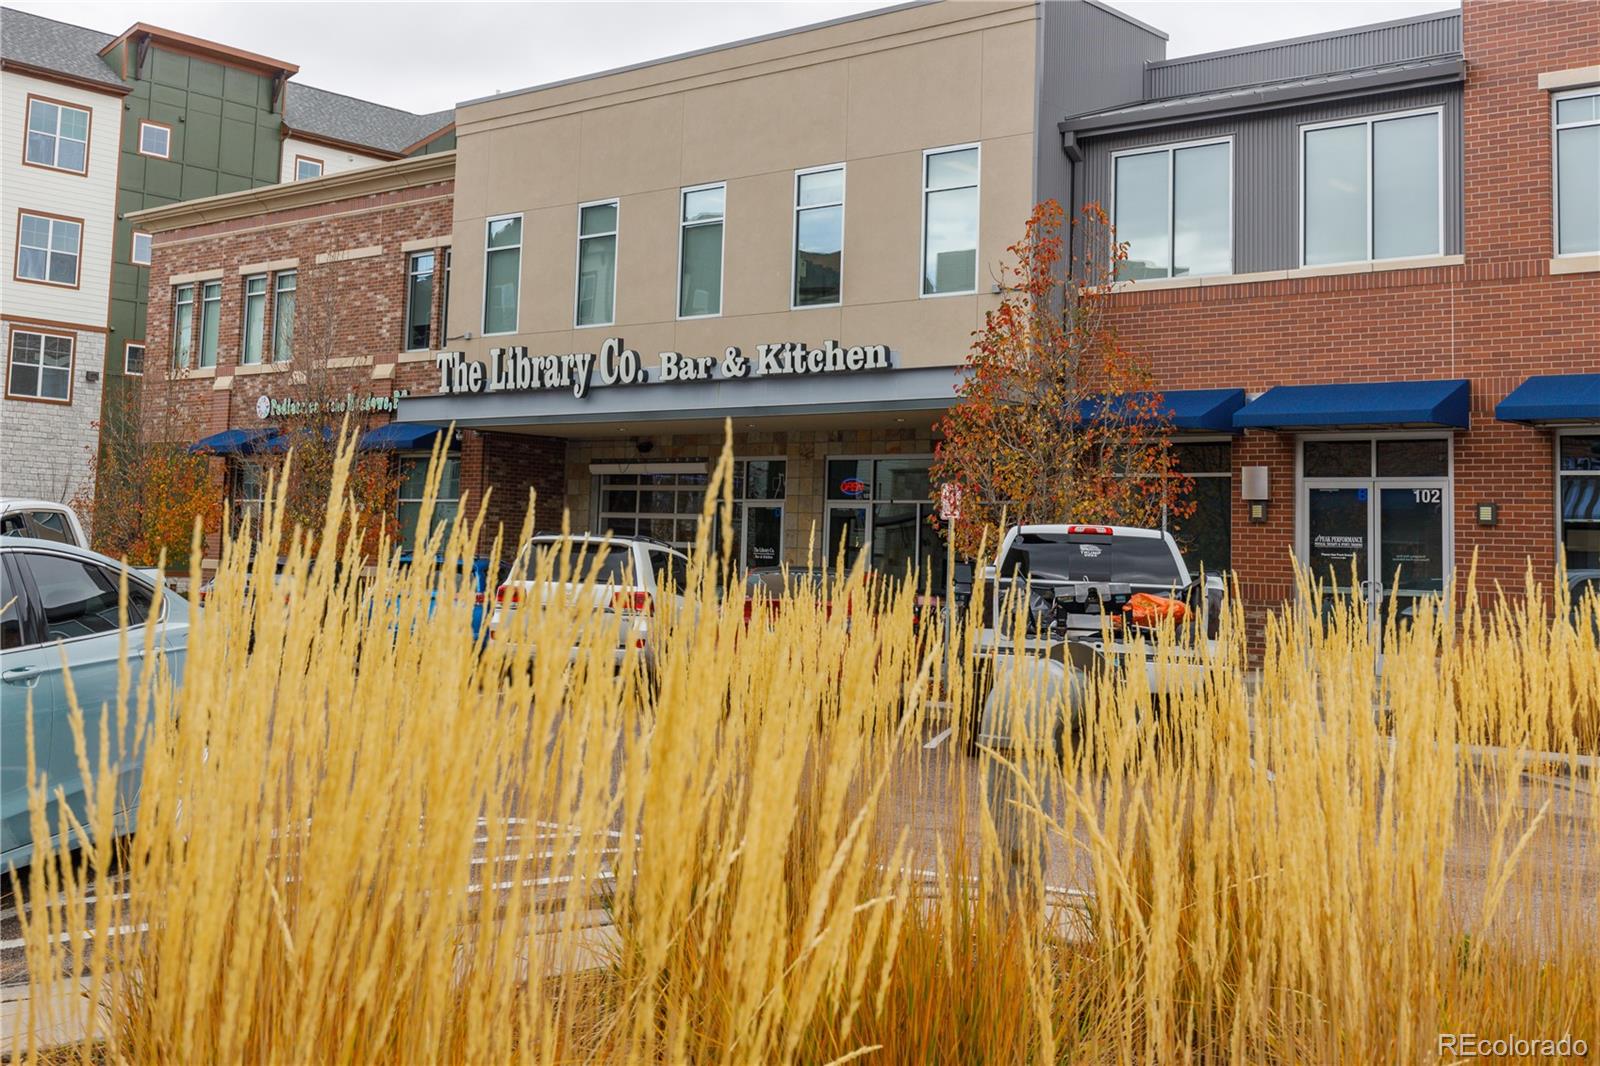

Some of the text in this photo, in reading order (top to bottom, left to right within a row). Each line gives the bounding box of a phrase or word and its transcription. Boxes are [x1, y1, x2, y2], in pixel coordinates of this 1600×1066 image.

[437, 337, 892, 398] The Library Co. Bar & Kitchen
[1413, 489, 1441, 503] 102
